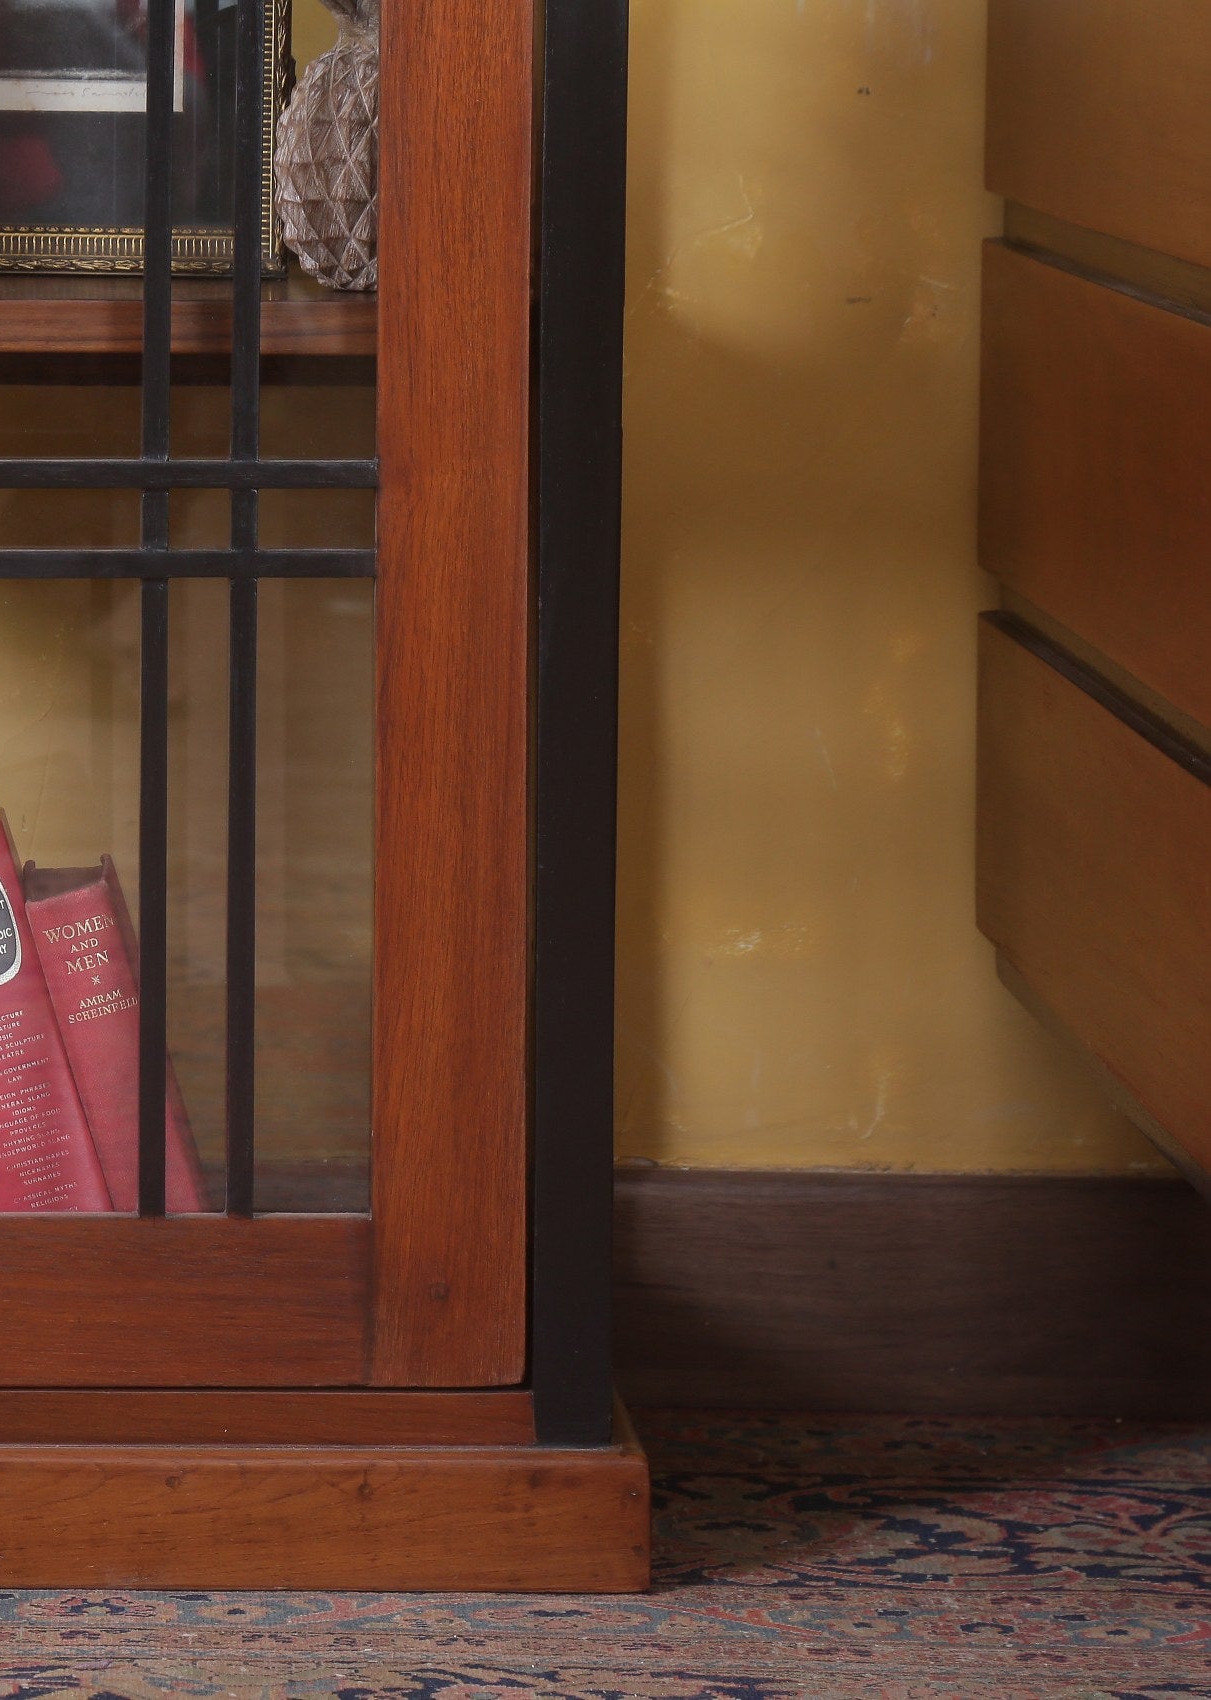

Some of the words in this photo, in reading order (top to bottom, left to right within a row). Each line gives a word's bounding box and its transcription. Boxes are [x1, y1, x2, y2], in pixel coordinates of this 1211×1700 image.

[42, 914, 115, 944] WOMEN
[70, 937, 99, 953] AND
[65, 950, 109, 975] MEN
[79, 989, 122, 1010] AMRAM
[68, 997, 138, 1024] SCHEINFELD
[5, 1033, 45, 1049] SCULPTURE
[7, 1075, 23, 1083] LAW
[19, 1081, 51, 1095] PHRASE
[12, 1105, 37, 1116] IDIOMS
